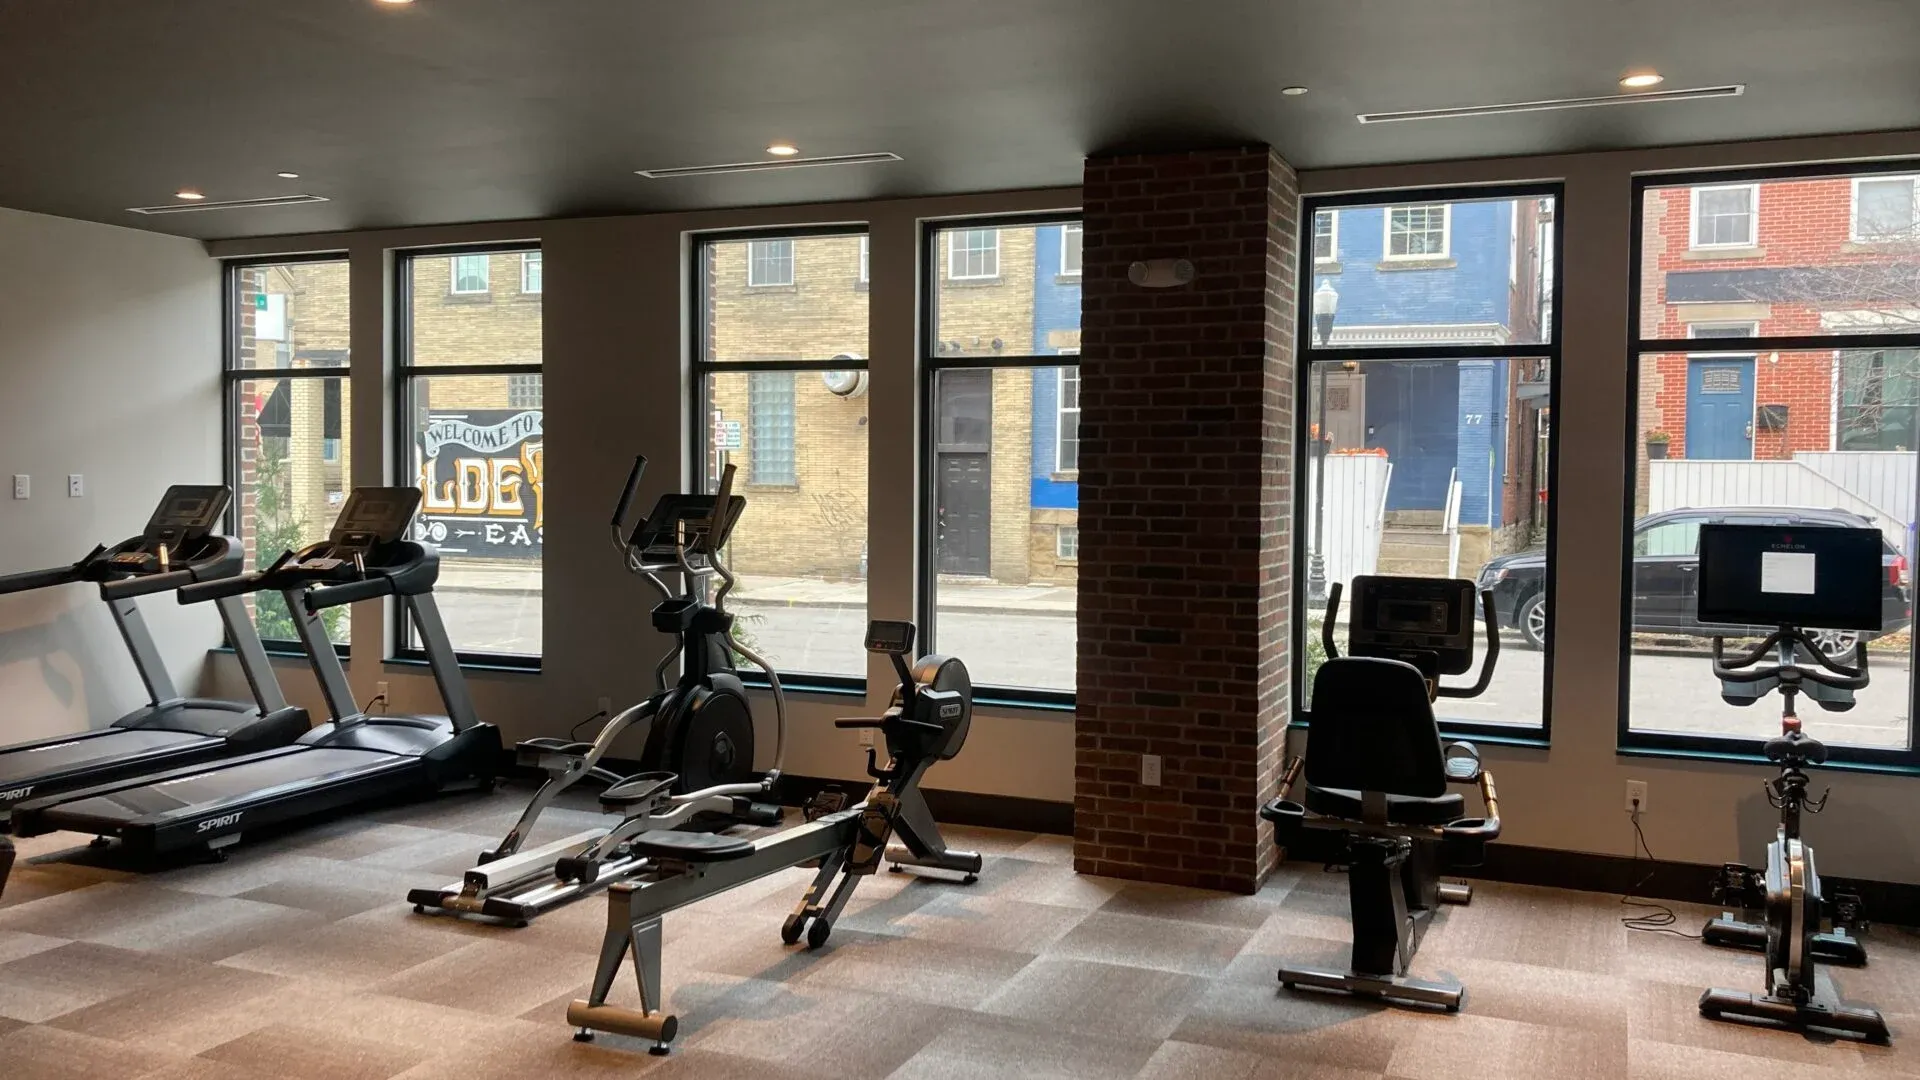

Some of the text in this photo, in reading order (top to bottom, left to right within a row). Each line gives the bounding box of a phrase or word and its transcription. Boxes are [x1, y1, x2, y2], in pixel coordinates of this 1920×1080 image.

[1465, 414, 1483, 425] 77
[429, 414, 533, 448] WELCOME TO
[416, 452, 525, 516] LDE
[0, 786, 35, 801] PIRIT
[196, 811, 244, 833] SPIRIT
